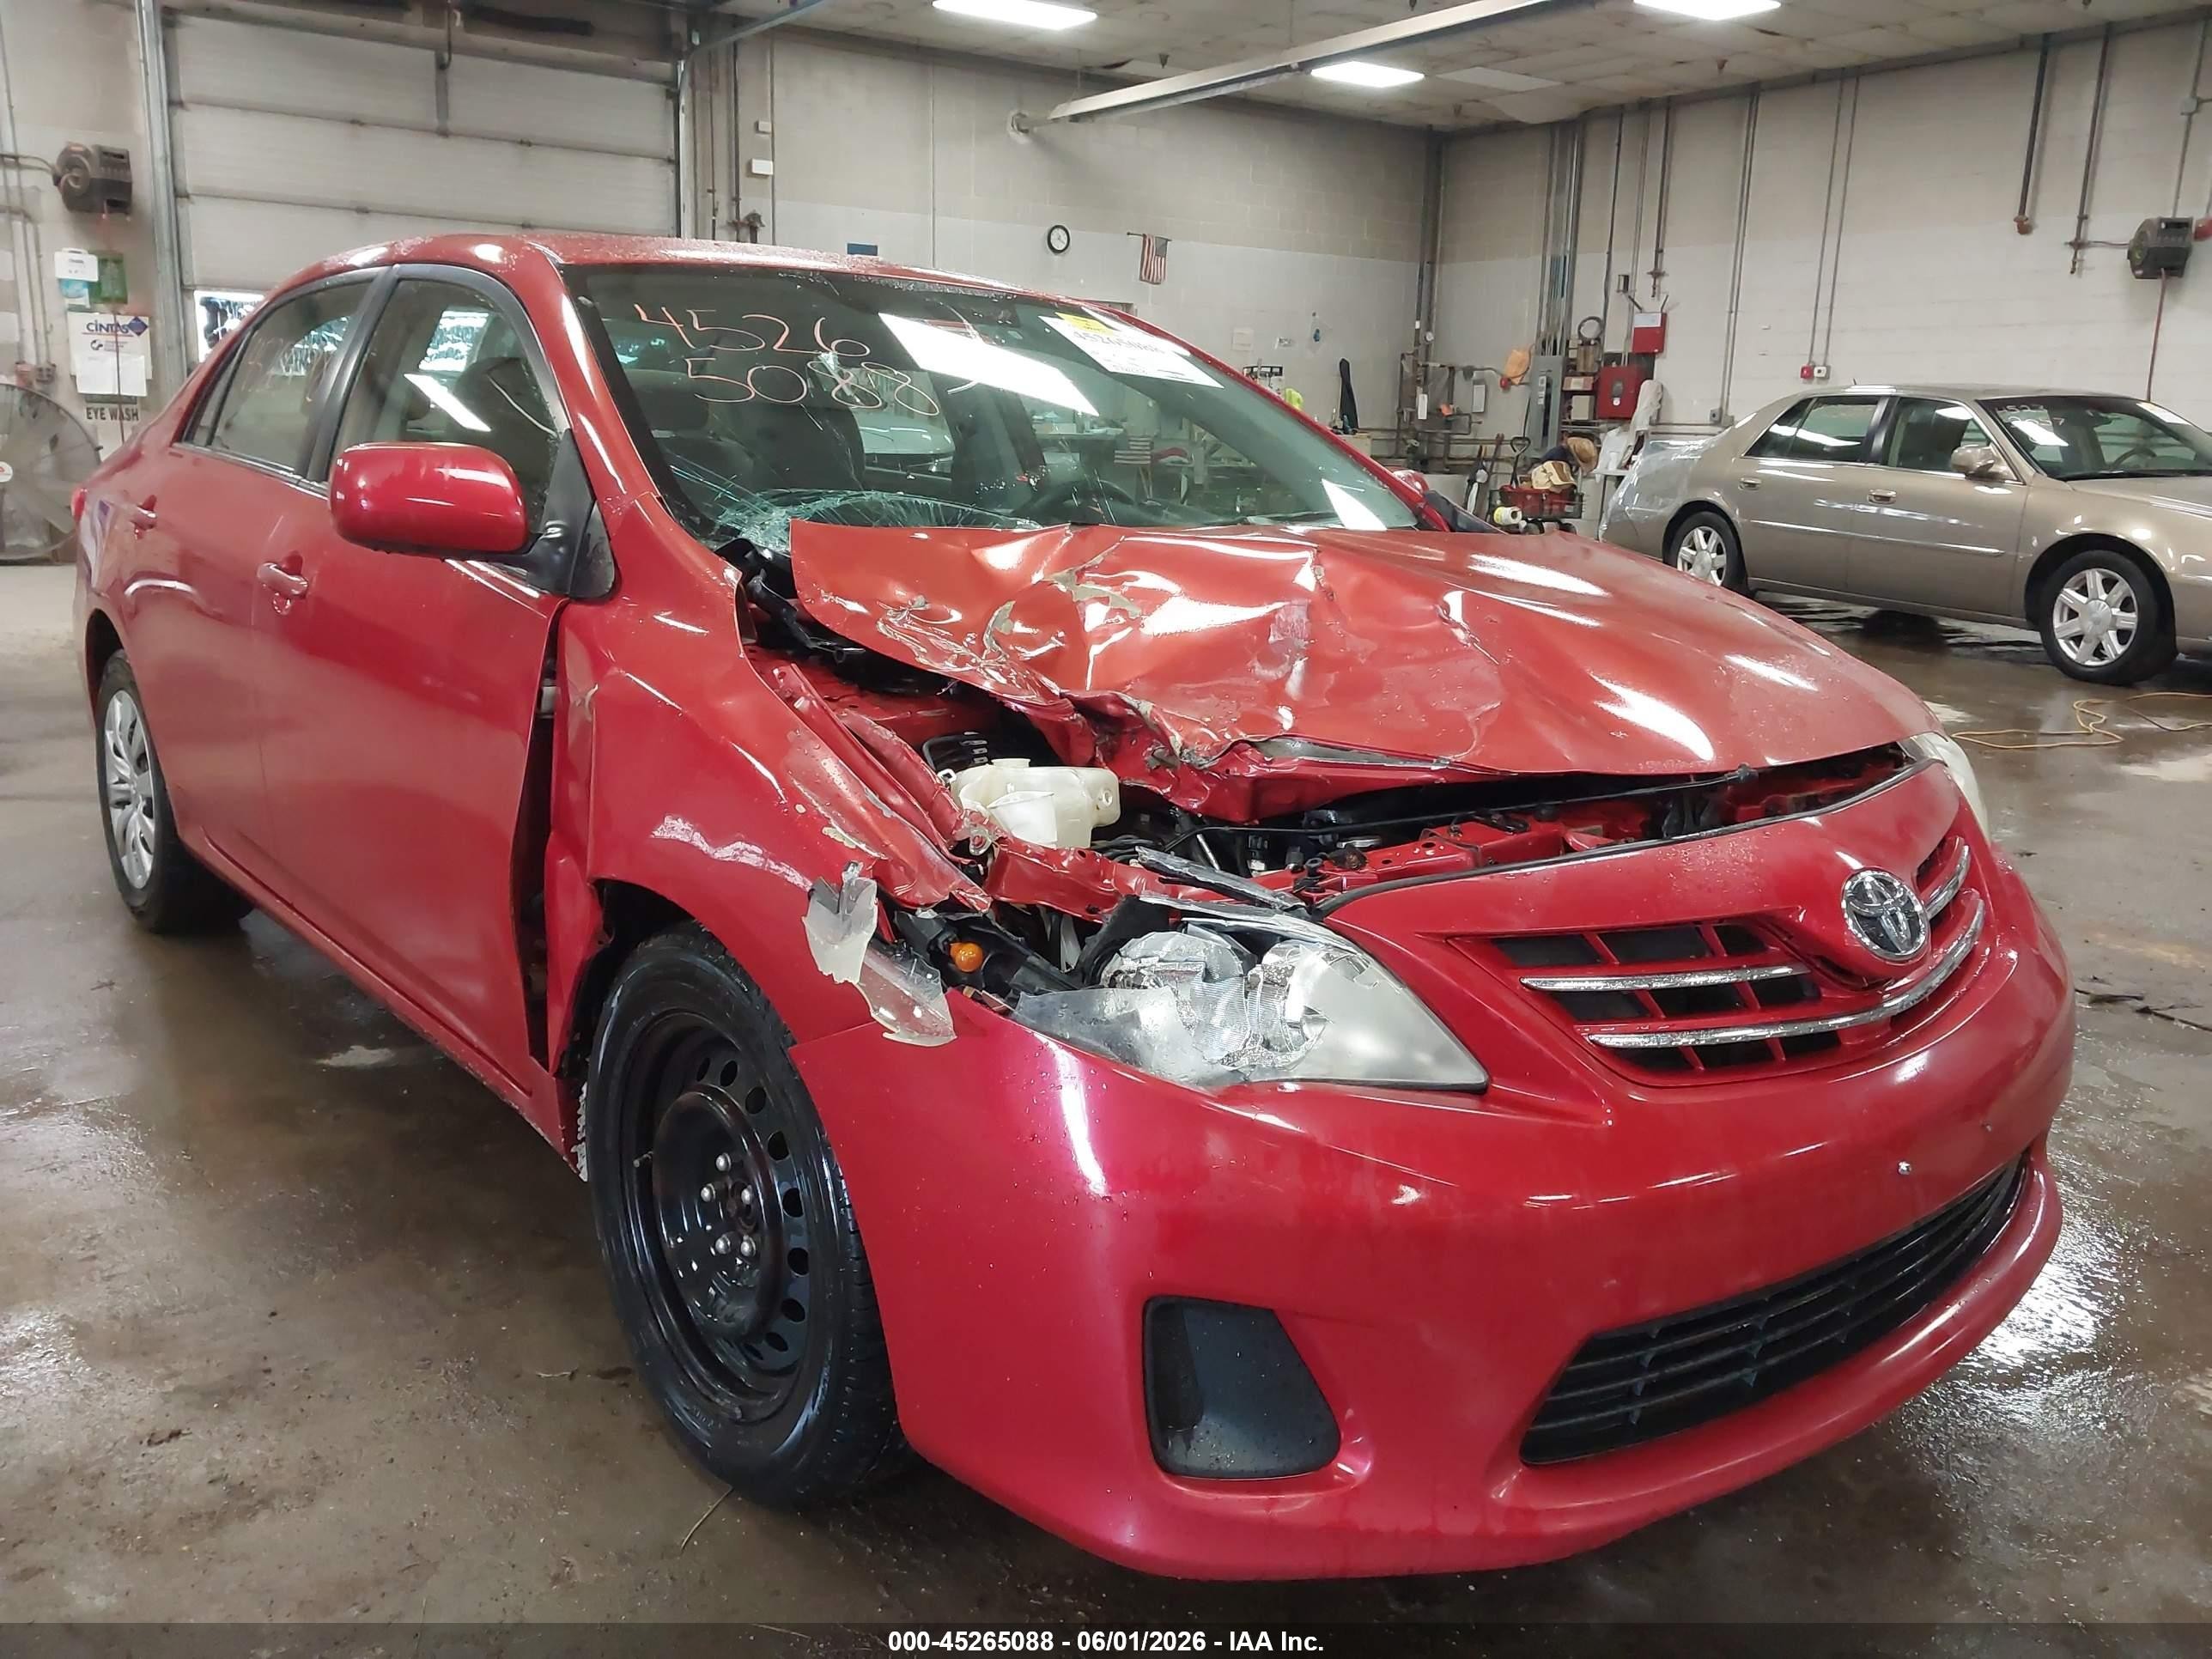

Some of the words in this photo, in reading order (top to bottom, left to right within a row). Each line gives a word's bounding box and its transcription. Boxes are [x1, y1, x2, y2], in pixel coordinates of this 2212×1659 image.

[634, 303, 871, 357] 4526
[684, 357, 939, 416] 5088
[86, 407, 106, 421] EYE
[108, 407, 139, 422] WASH
